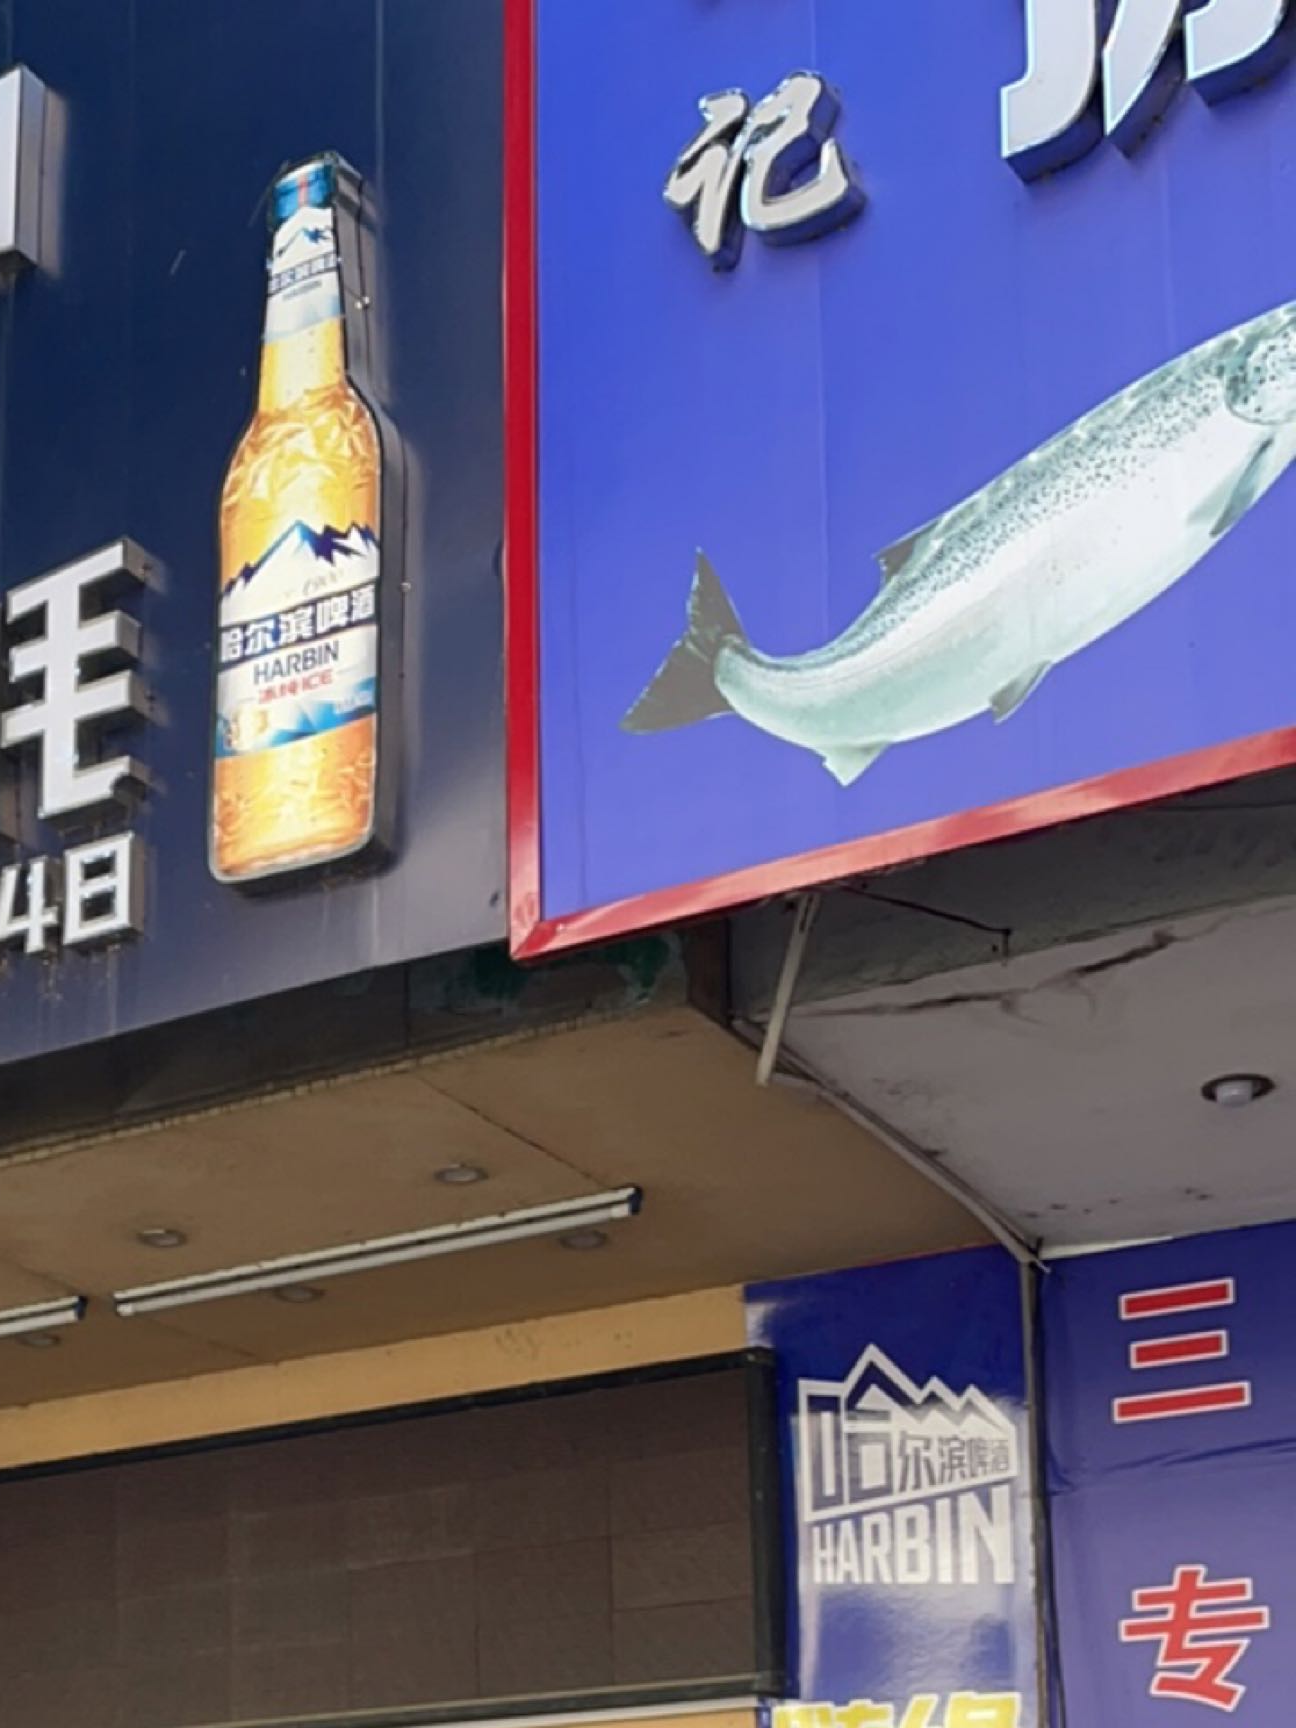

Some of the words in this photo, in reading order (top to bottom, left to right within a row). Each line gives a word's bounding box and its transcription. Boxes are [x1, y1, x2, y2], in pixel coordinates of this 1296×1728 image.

[664, 71, 850, 256] 记
[254, 640, 340, 685] HARBIN
[812, 1485, 1015, 1585] HARBIN
